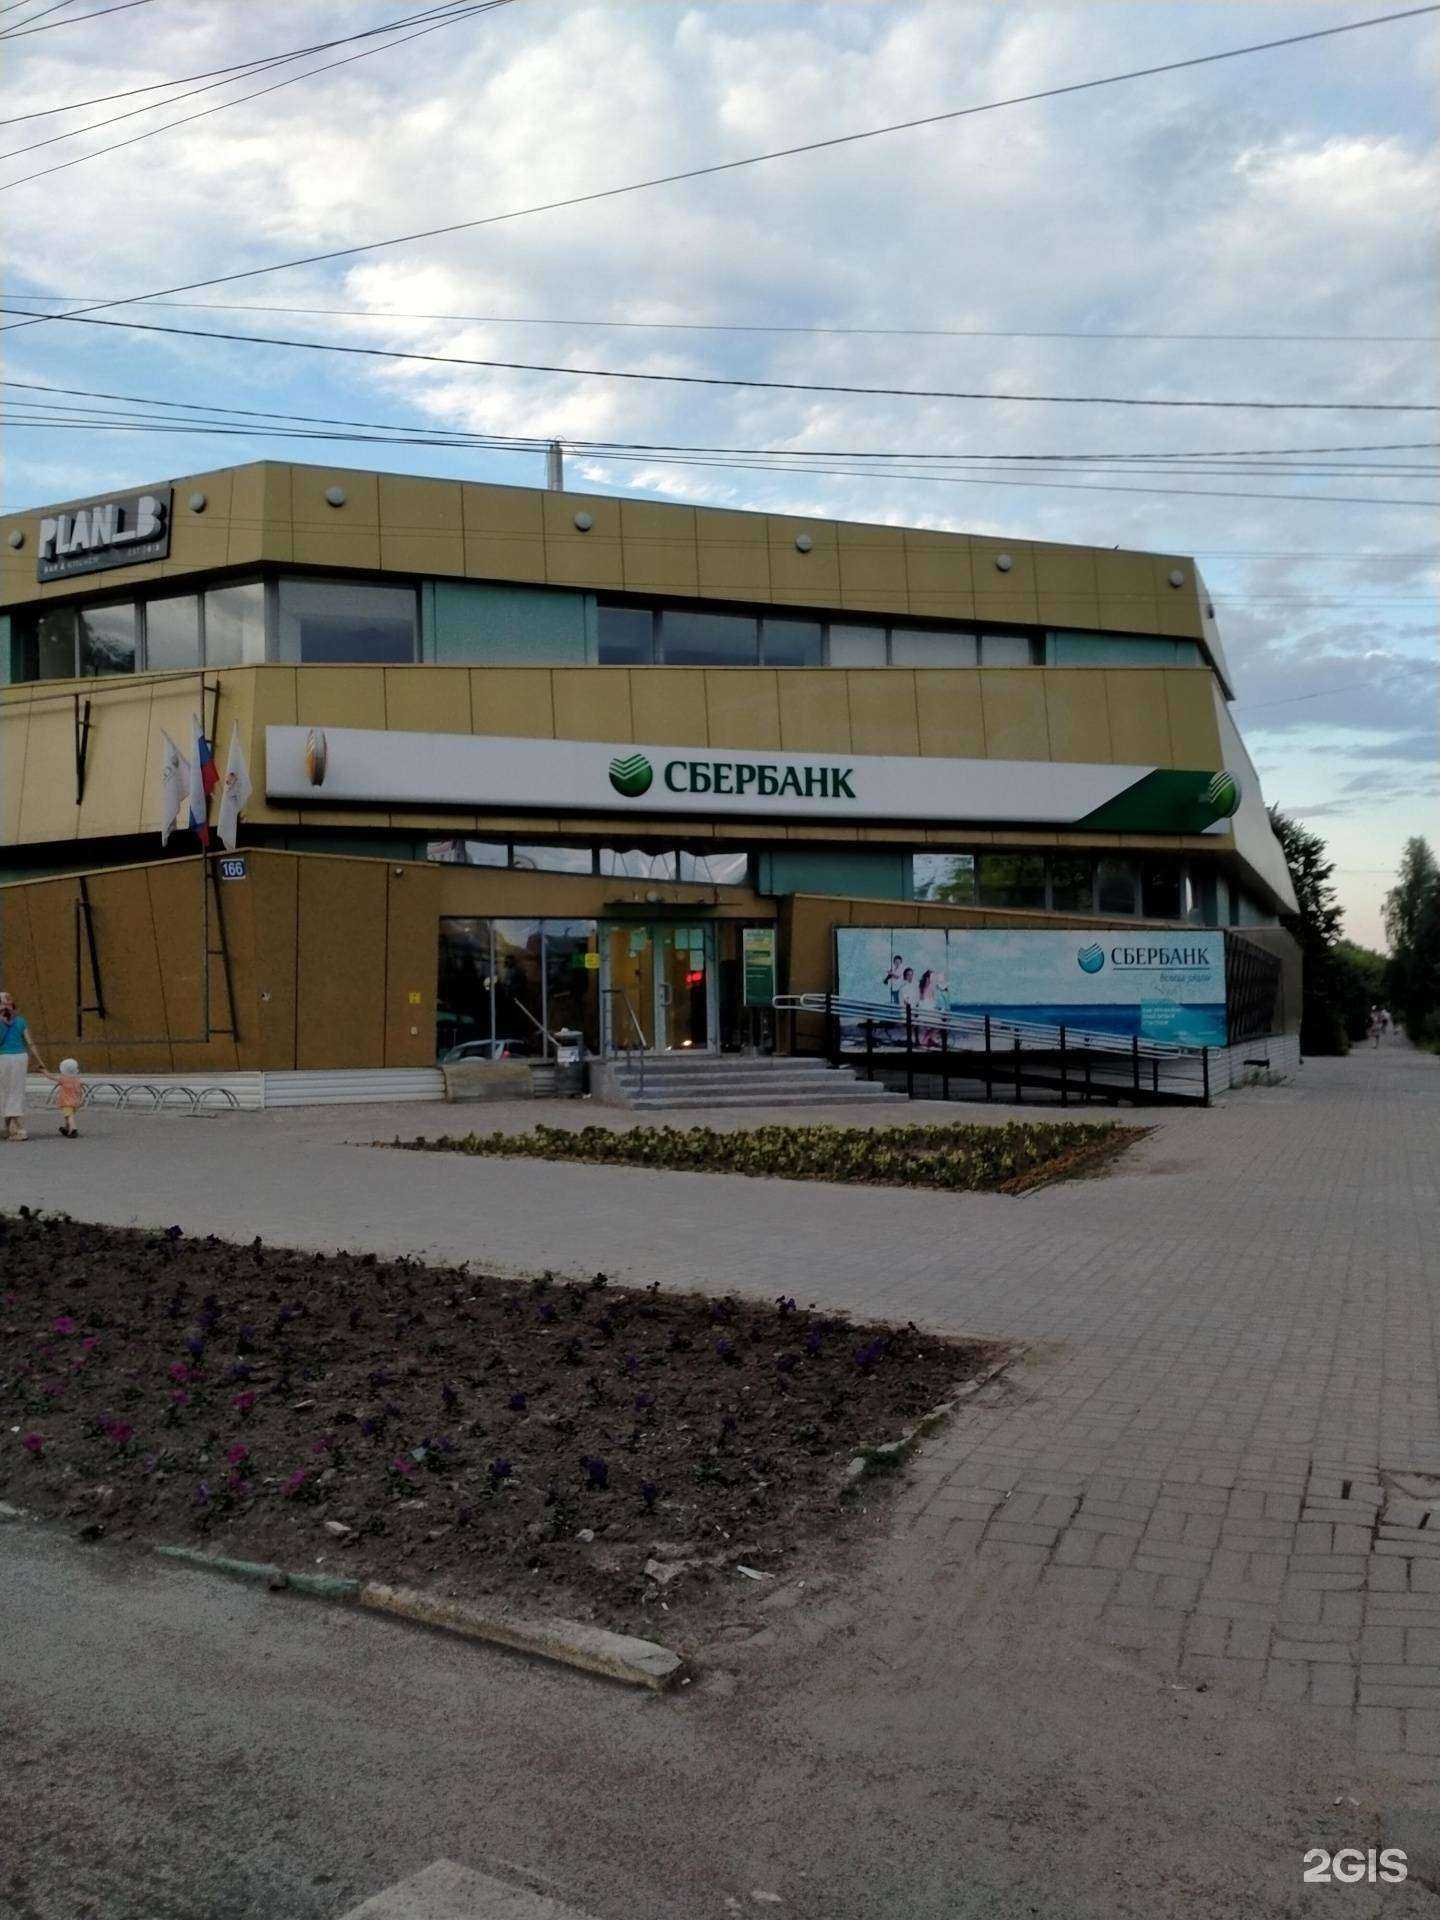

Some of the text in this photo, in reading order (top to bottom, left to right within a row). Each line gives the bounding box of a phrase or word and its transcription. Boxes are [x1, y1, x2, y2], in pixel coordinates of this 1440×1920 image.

[664, 760, 857, 799] СБЕРБАНК
[222, 861, 244, 876] 166
[1111, 946, 1210, 966] СБЕРБАНК
